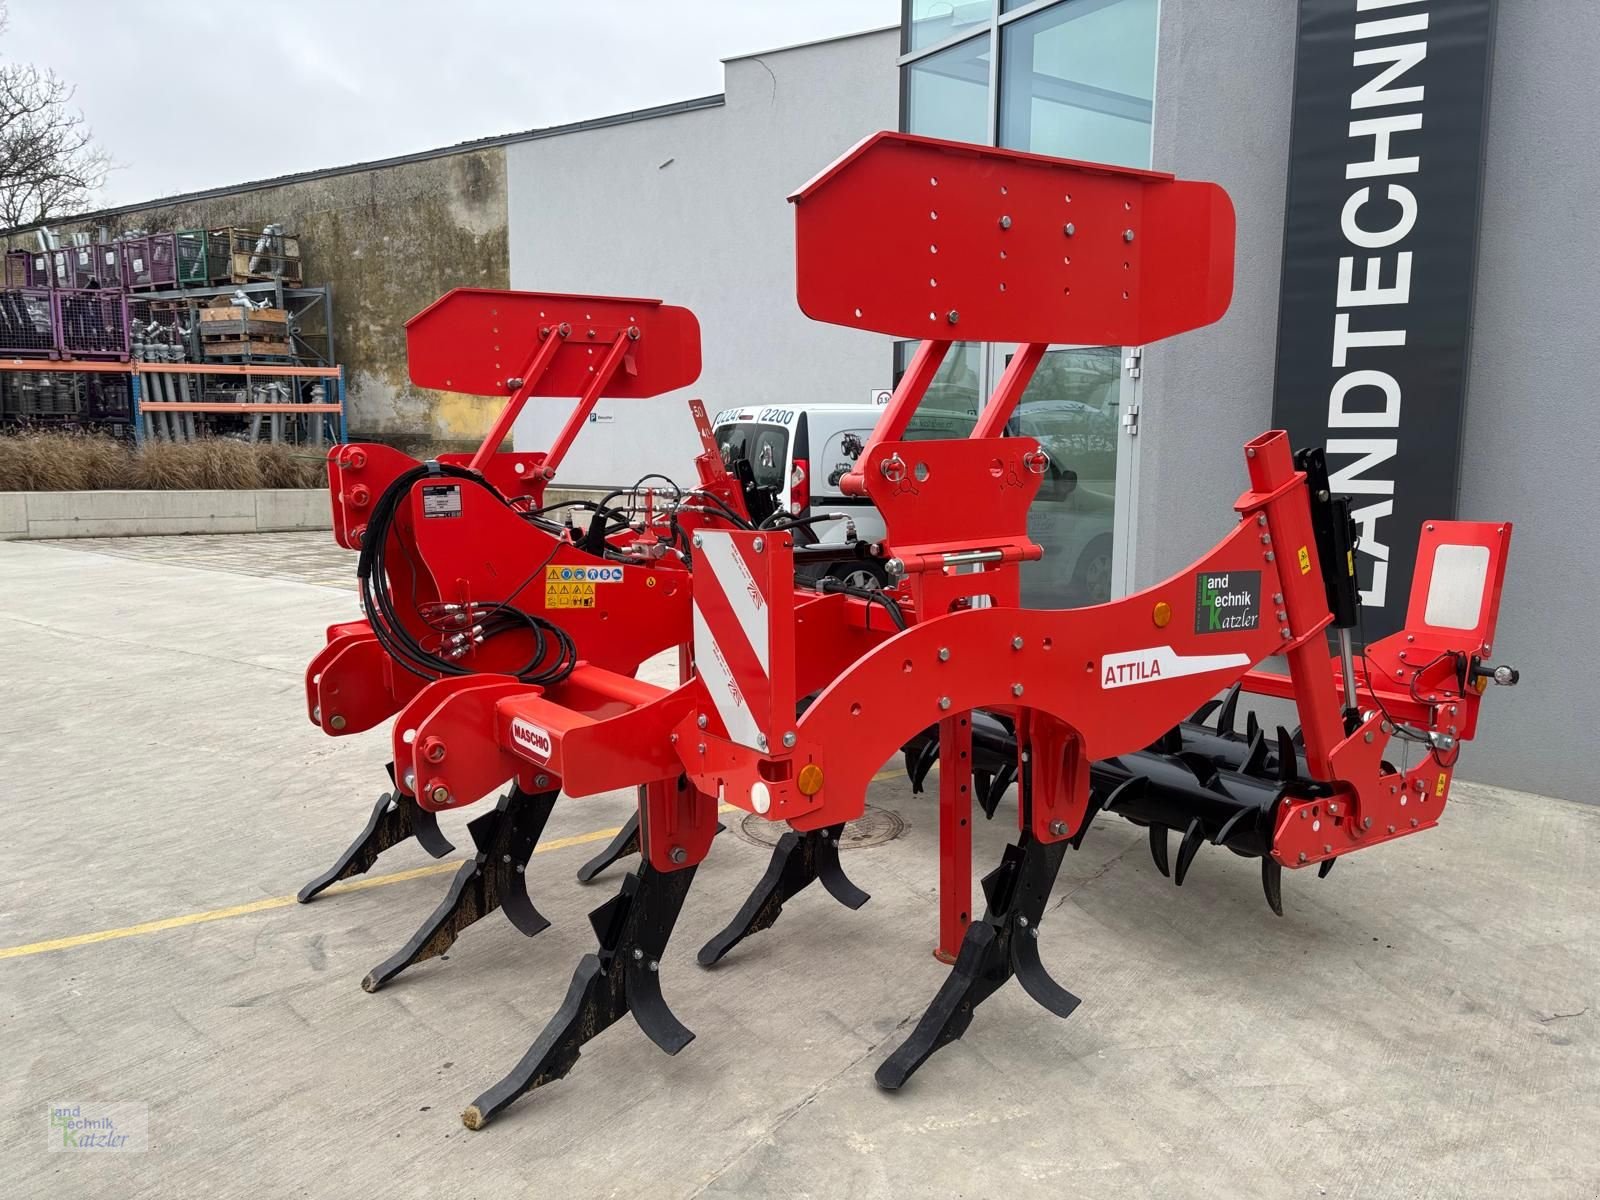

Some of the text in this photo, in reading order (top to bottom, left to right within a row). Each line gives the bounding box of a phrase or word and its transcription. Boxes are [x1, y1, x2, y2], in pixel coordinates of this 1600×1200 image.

[1326, 0, 1429, 607] LANDTECHNI
[693, 405, 704, 418] 50
[761, 408, 794, 425] 2200
[1210, 607, 1259, 630] Katzler
[1104, 658, 1161, 685] ATTILA
[513, 724, 549, 753] MASCHIO
